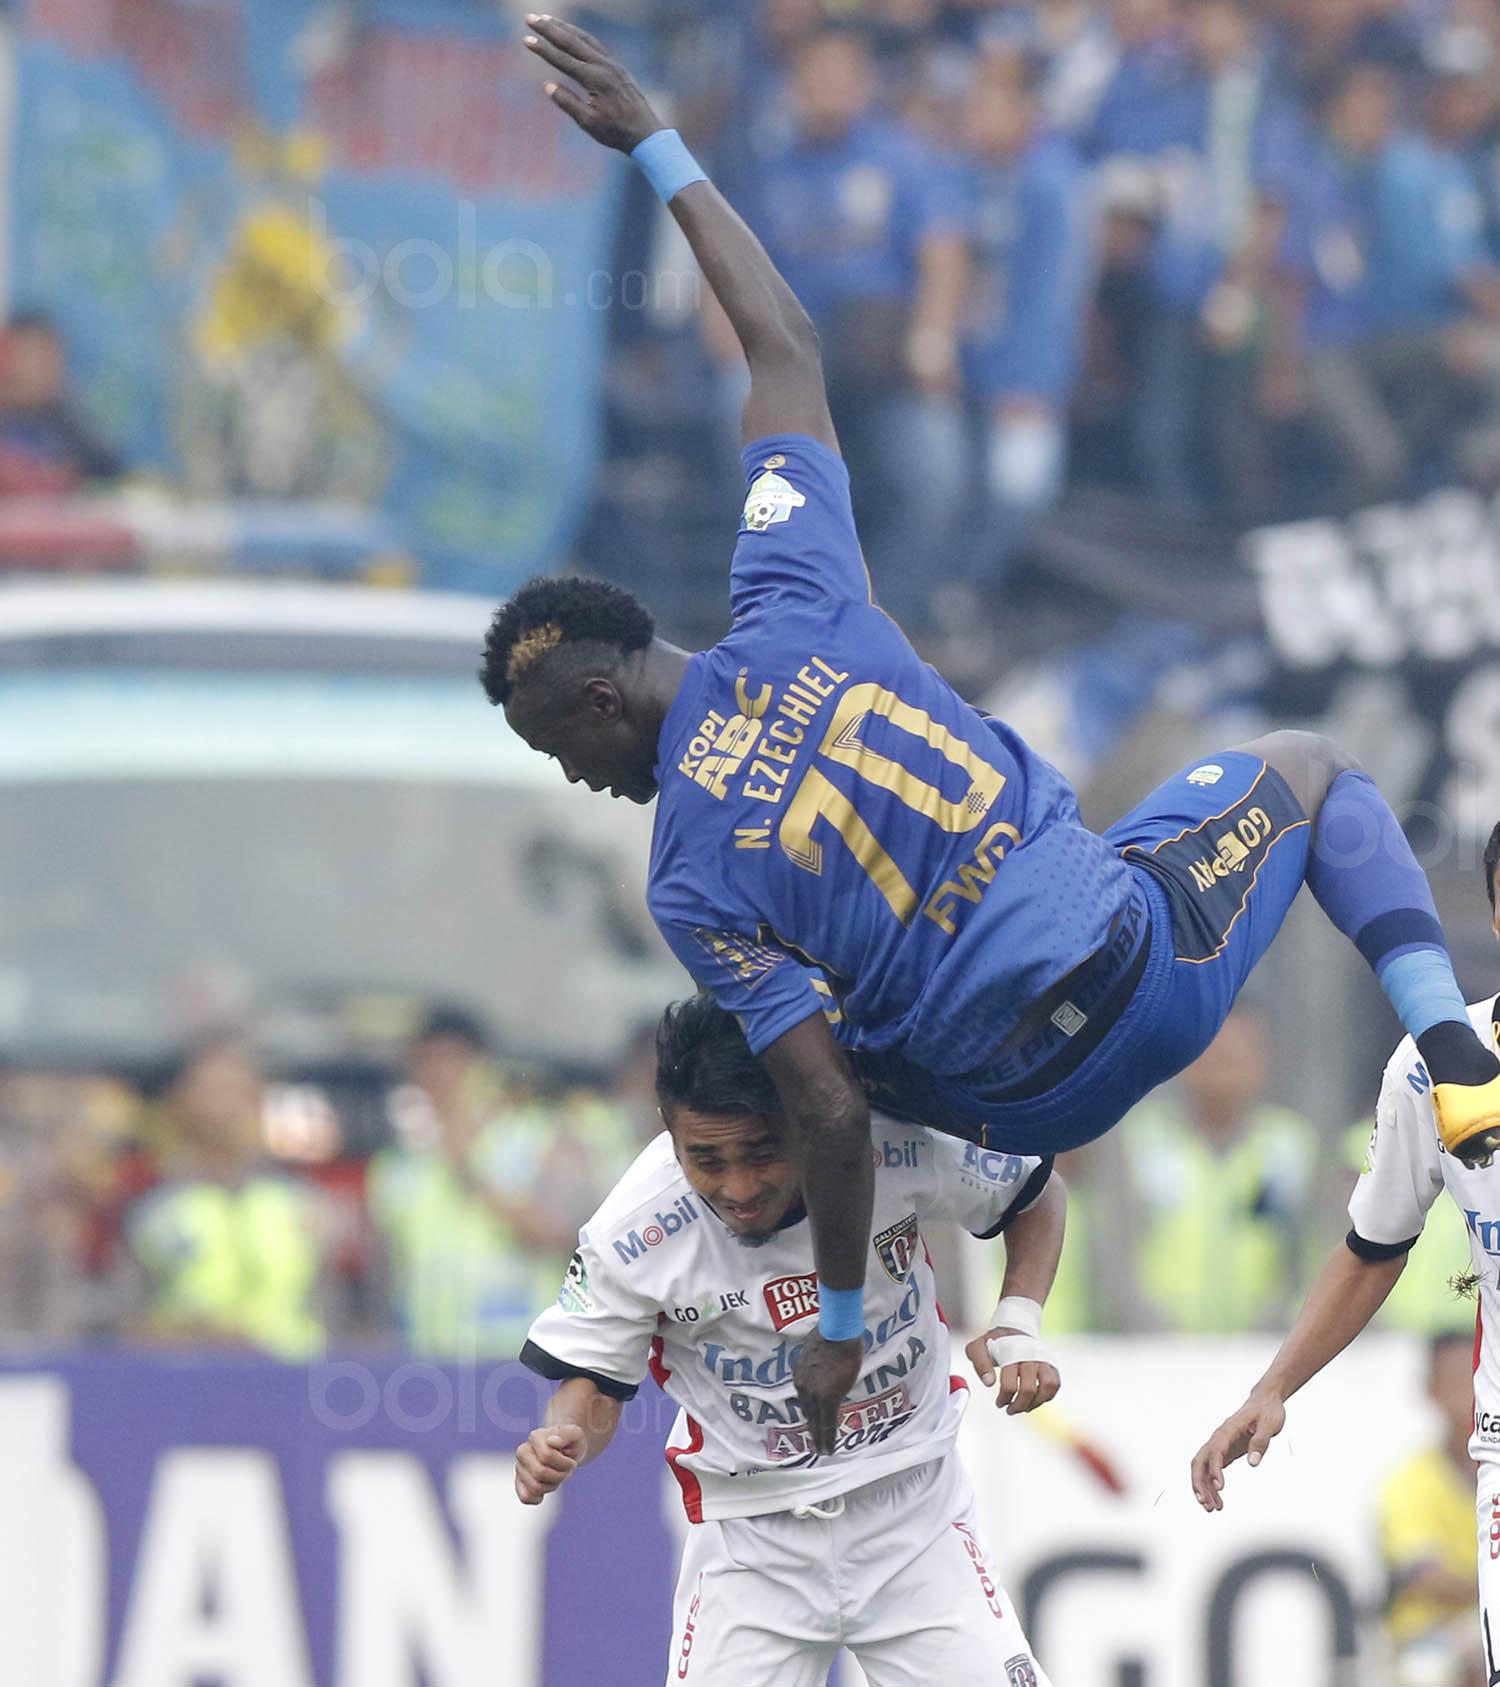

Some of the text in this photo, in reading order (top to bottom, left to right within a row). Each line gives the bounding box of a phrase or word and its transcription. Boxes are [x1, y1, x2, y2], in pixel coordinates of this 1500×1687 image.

[678, 709, 726, 777] KOPI
[693, 668, 773, 800] ABC
[742, 656, 849, 804] EZECHIEL
[779, 682, 1006, 925] 70
[734, 818, 771, 849] N.
[964, 1143, 1023, 1184] ACA
[611, 1193, 699, 1266] Mobil
[675, 1290, 751, 1323] GO JEK
[767, 1278, 818, 1302] TOR
[777, 1293, 819, 1321] BIK
